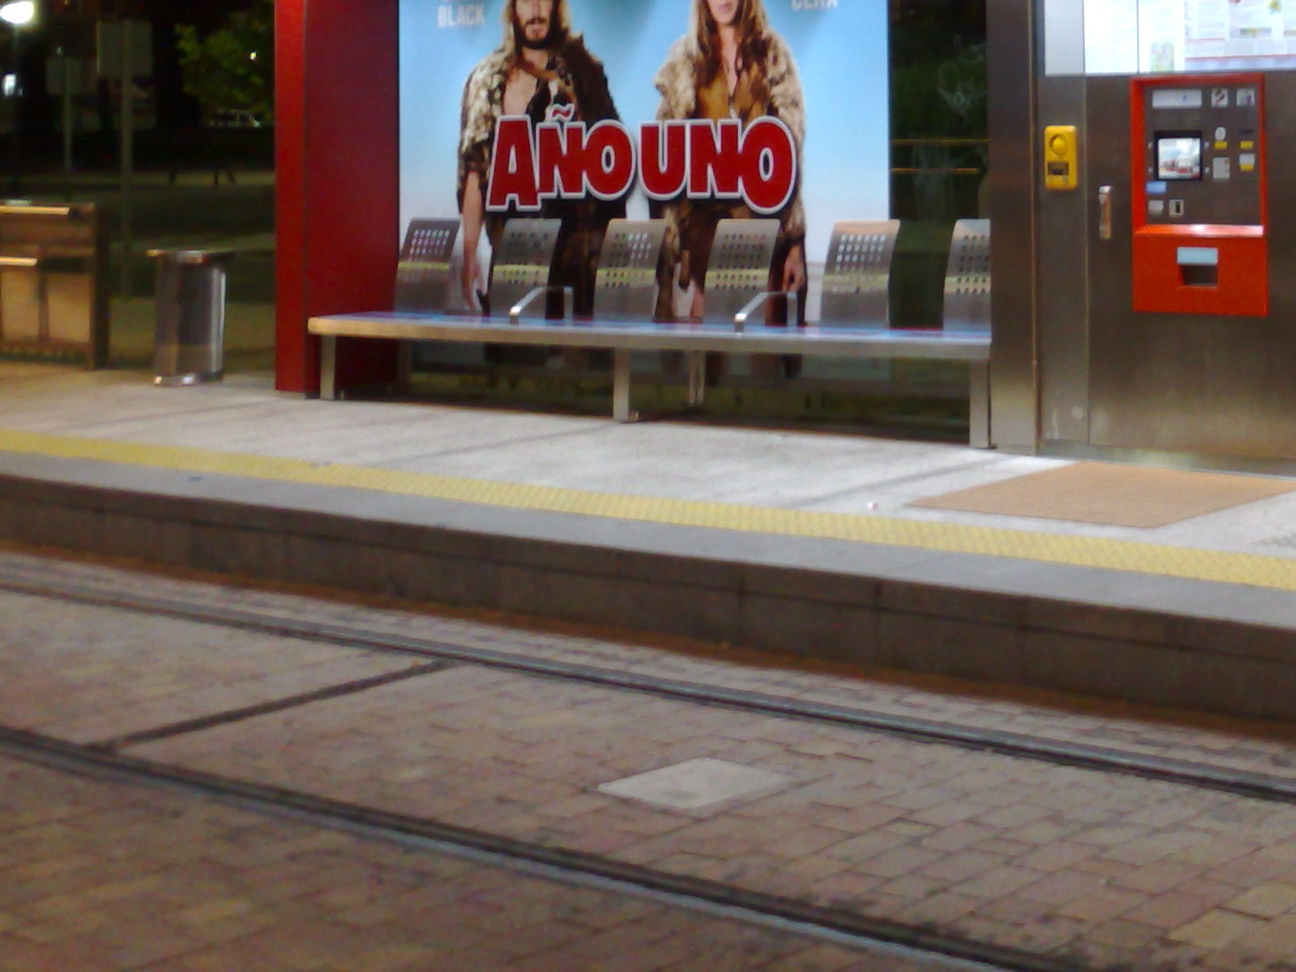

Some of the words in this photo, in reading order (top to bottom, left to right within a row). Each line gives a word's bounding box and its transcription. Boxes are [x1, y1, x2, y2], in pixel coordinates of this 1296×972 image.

[437, 4, 484, 28] BLACK
[486, 104, 636, 212] AÑO
[638, 116, 797, 215] UNO
